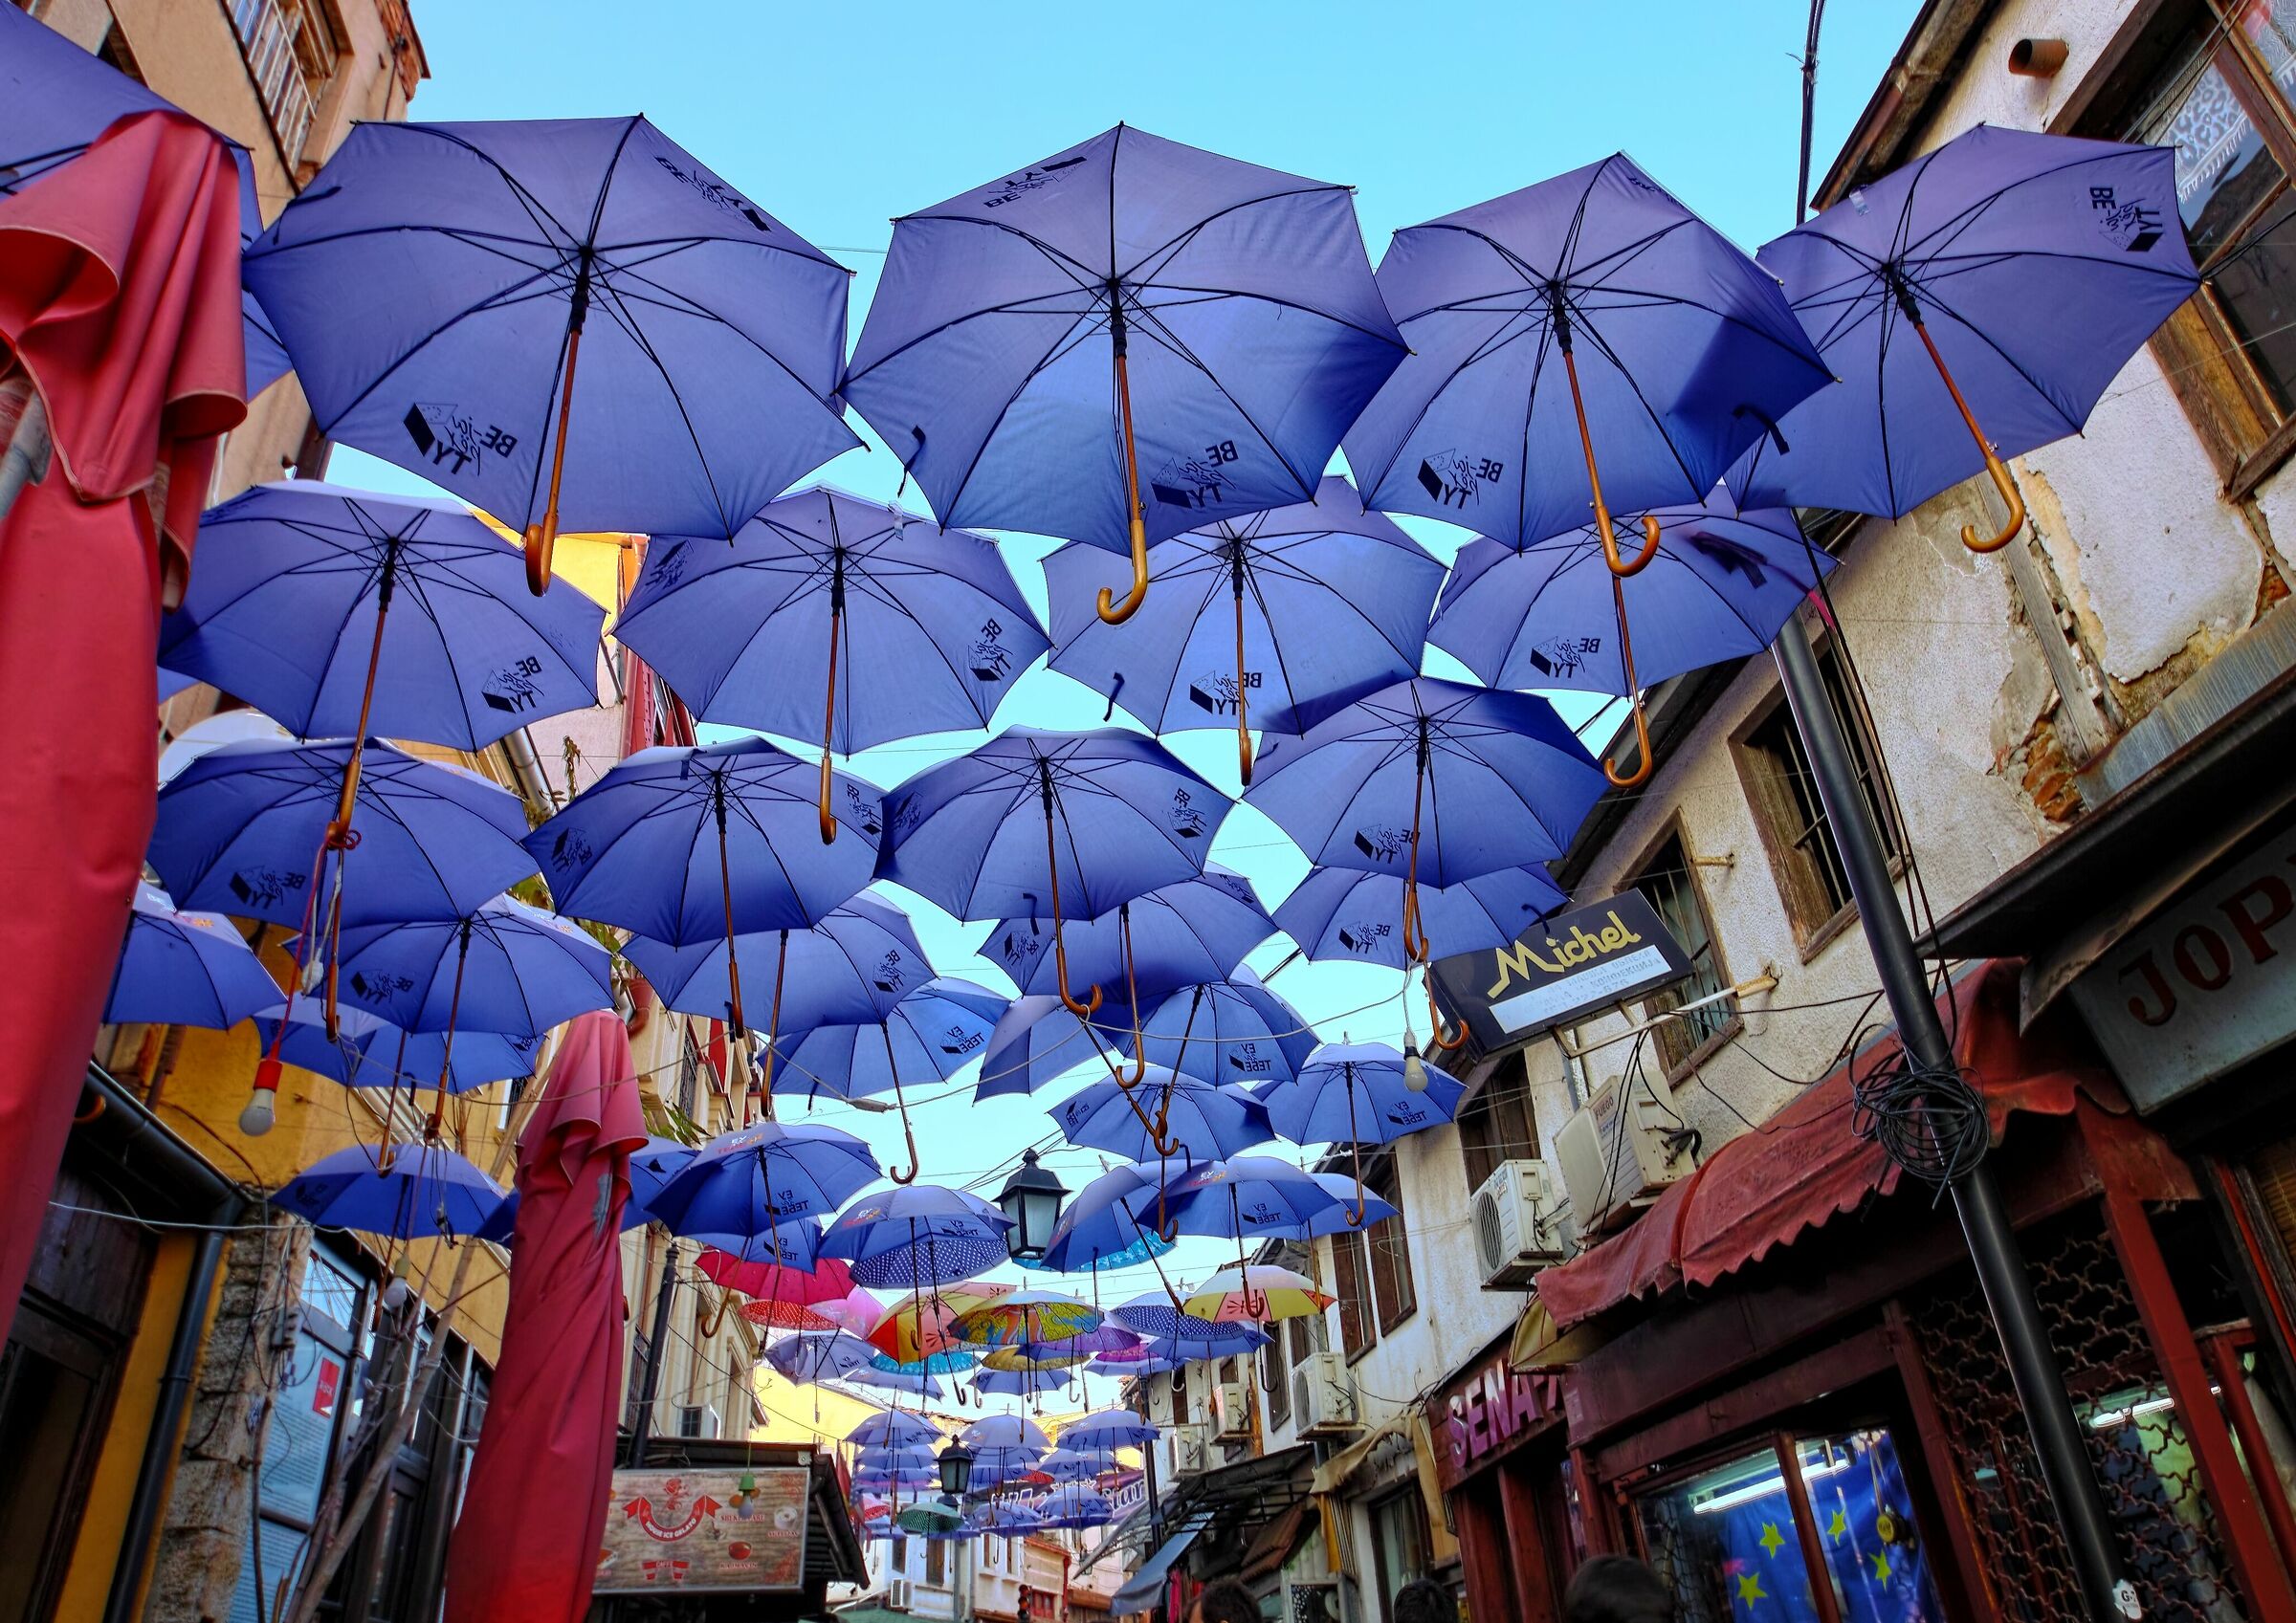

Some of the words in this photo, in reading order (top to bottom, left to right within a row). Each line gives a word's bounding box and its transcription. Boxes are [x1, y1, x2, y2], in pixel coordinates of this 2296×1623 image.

[1488, 910, 1642, 998] Michel
[1595, 1096, 1614, 1120] FUEGO
[673, 1518, 696, 1537] GELATO
